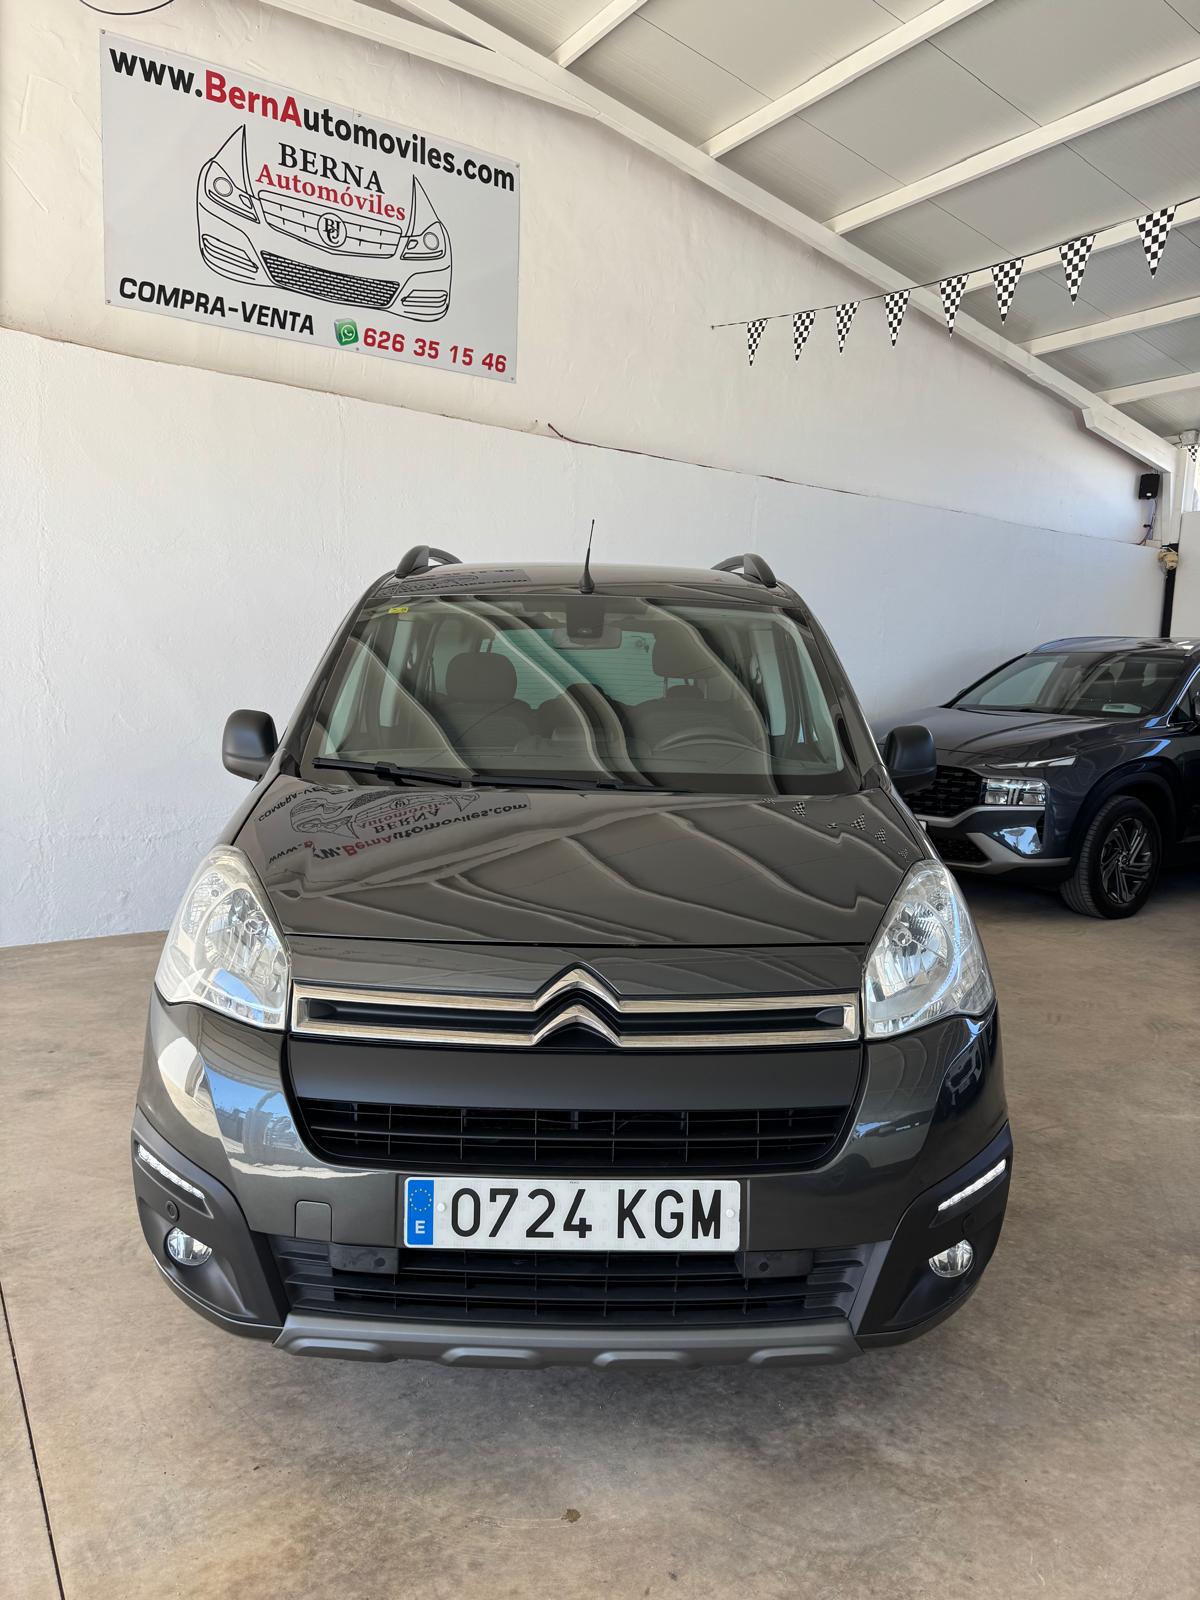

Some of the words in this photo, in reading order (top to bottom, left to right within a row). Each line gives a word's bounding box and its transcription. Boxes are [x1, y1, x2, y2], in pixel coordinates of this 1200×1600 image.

[109, 48, 515, 191] www.BernAutomoviles.com
[256, 164, 406, 221] Automóviles
[278, 142, 385, 194] BERNA
[119, 277, 314, 335] COMPRA-VENTA
[363, 327, 405, 354] 626
[413, 337, 440, 360] 35
[449, 345, 474, 366] 15
[481, 352, 507, 373] 46
[415, 1220, 426, 1234] E
[451, 1188, 592, 1239] 0724
[617, 1188, 721, 1240] KGM
